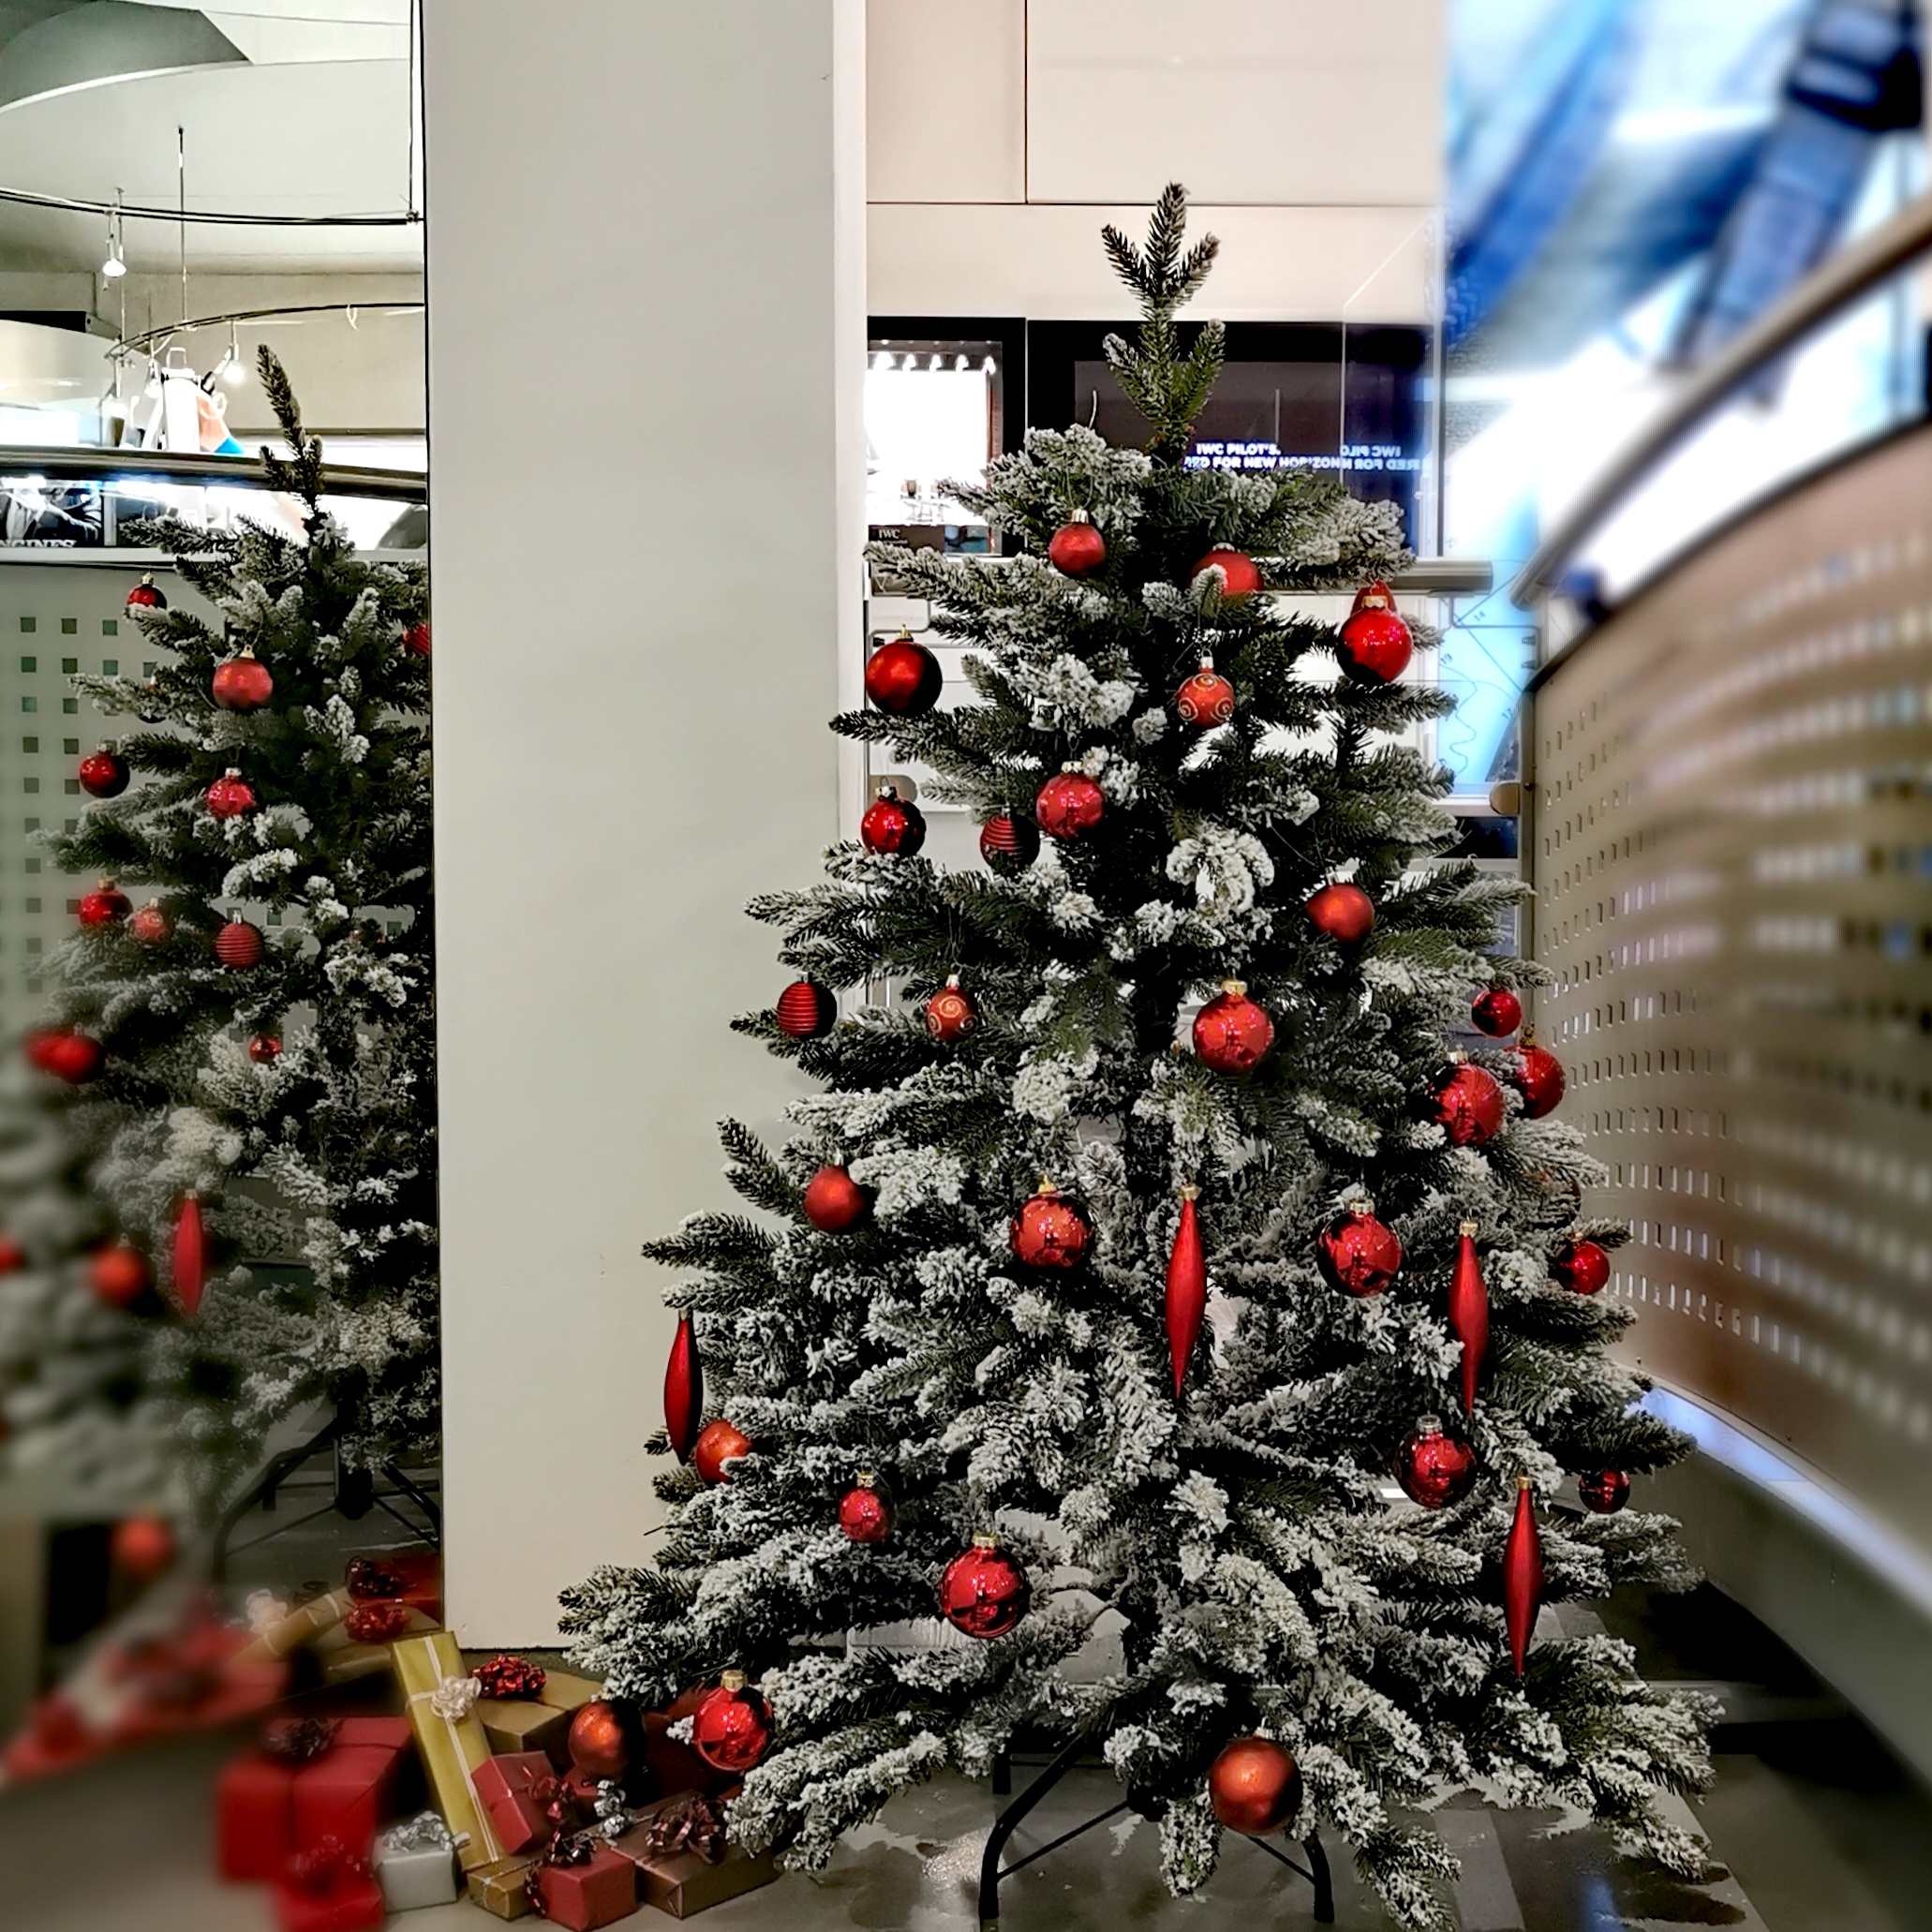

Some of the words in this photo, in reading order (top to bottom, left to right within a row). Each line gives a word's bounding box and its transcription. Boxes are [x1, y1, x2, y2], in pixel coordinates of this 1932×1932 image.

[1196, 443, 1224, 454] IWC
[1212, 456, 1241, 468] FOR
[1243, 456, 1276, 468] NEW
[879, 529, 900, 539] IWC
